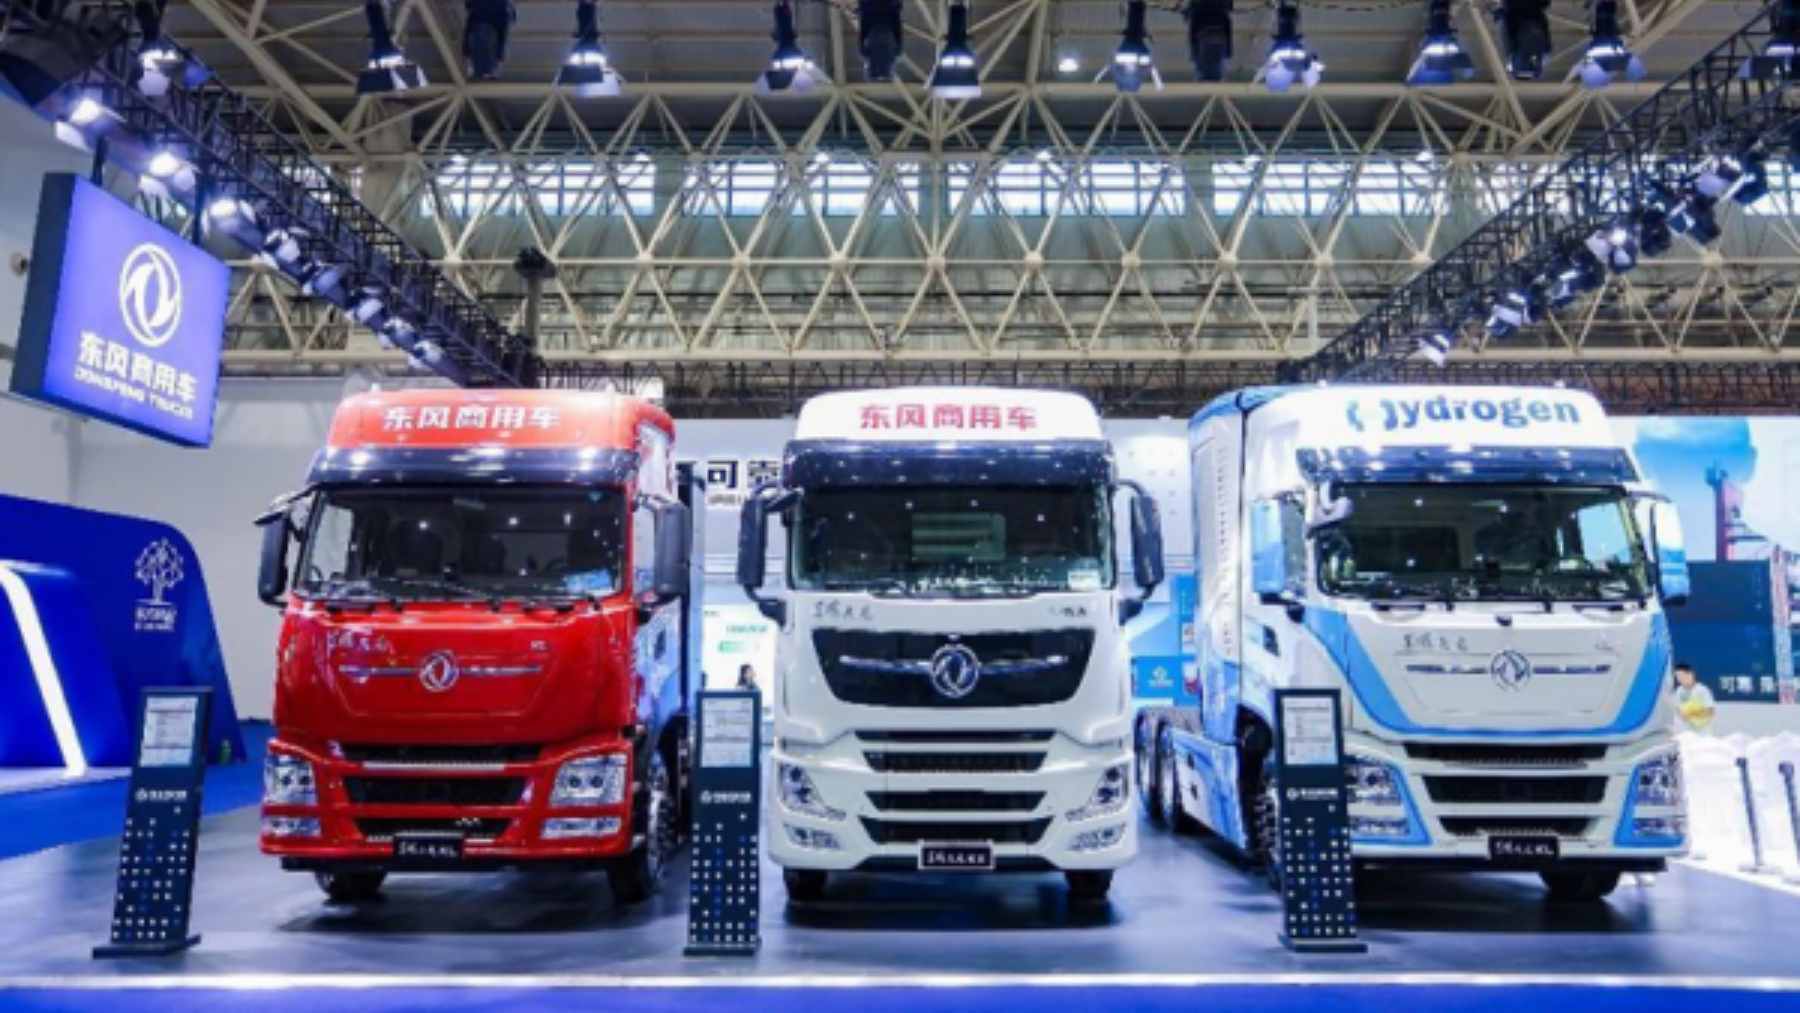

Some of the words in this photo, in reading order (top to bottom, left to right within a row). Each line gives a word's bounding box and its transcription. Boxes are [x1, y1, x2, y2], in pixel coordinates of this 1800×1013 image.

[79, 332, 197, 401] 东风商用车
[384, 405, 560, 429] 东风商用车
[859, 403, 1037, 430] 东风商用车
